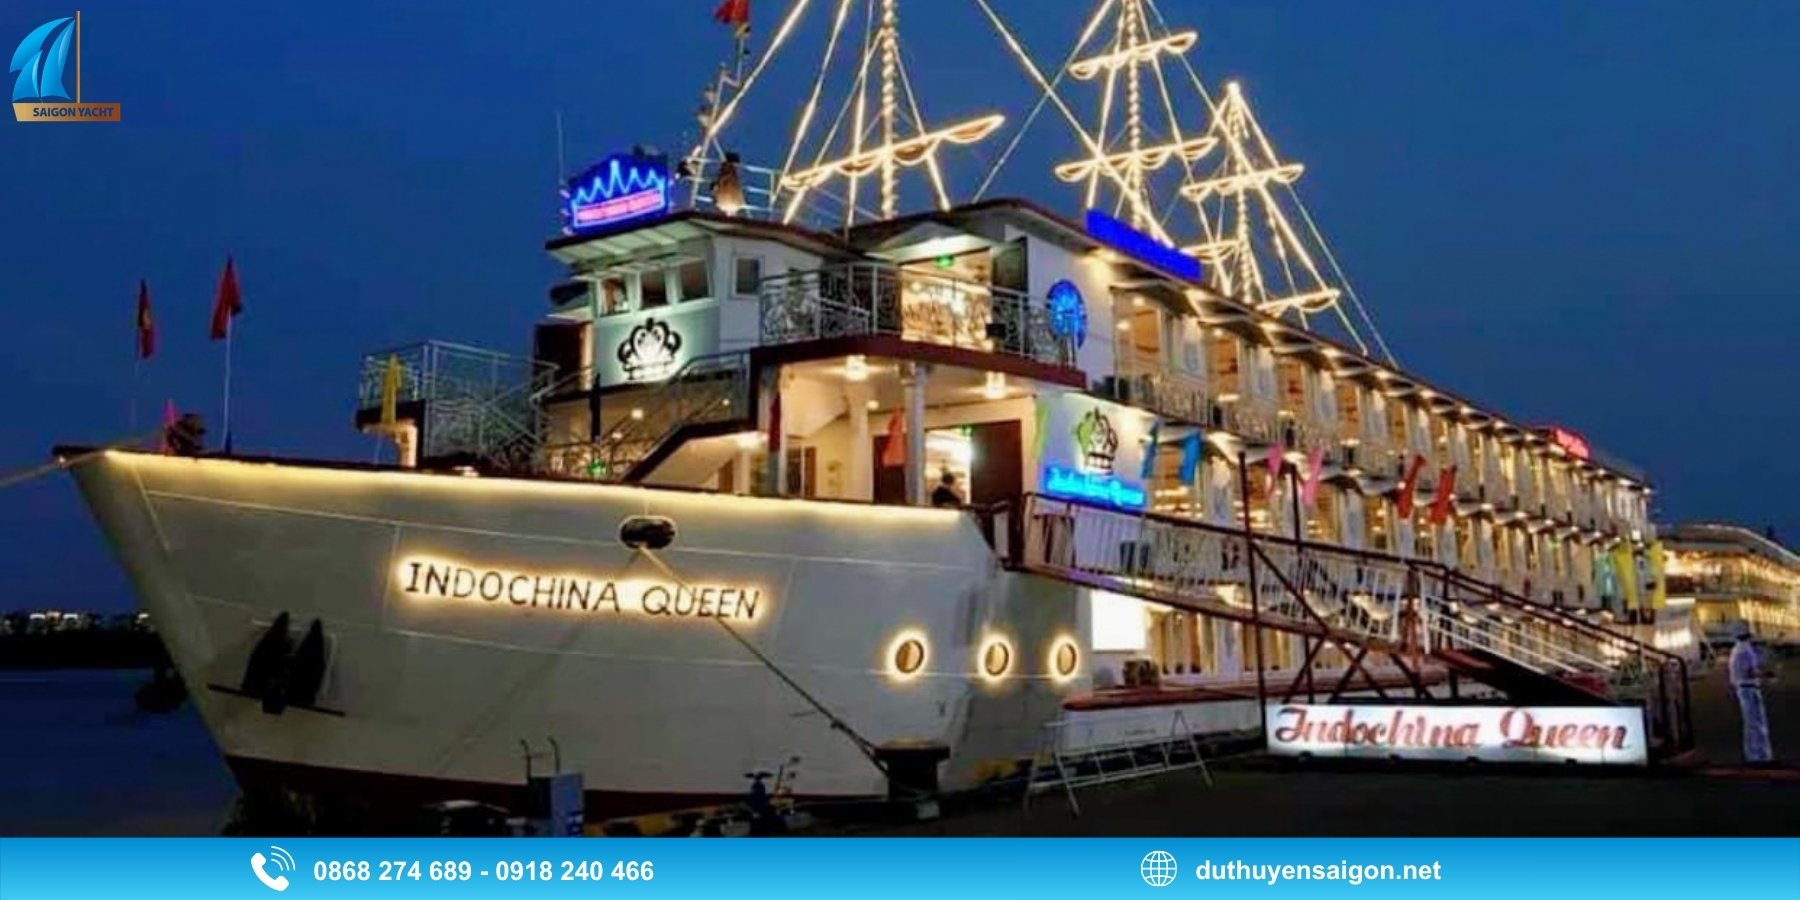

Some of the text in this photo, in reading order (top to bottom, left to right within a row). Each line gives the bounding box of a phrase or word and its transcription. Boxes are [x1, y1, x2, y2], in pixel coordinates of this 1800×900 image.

[404, 561, 760, 618] INDOCHINA QUEEN
[1275, 707, 1630, 749] Indochina Queen
